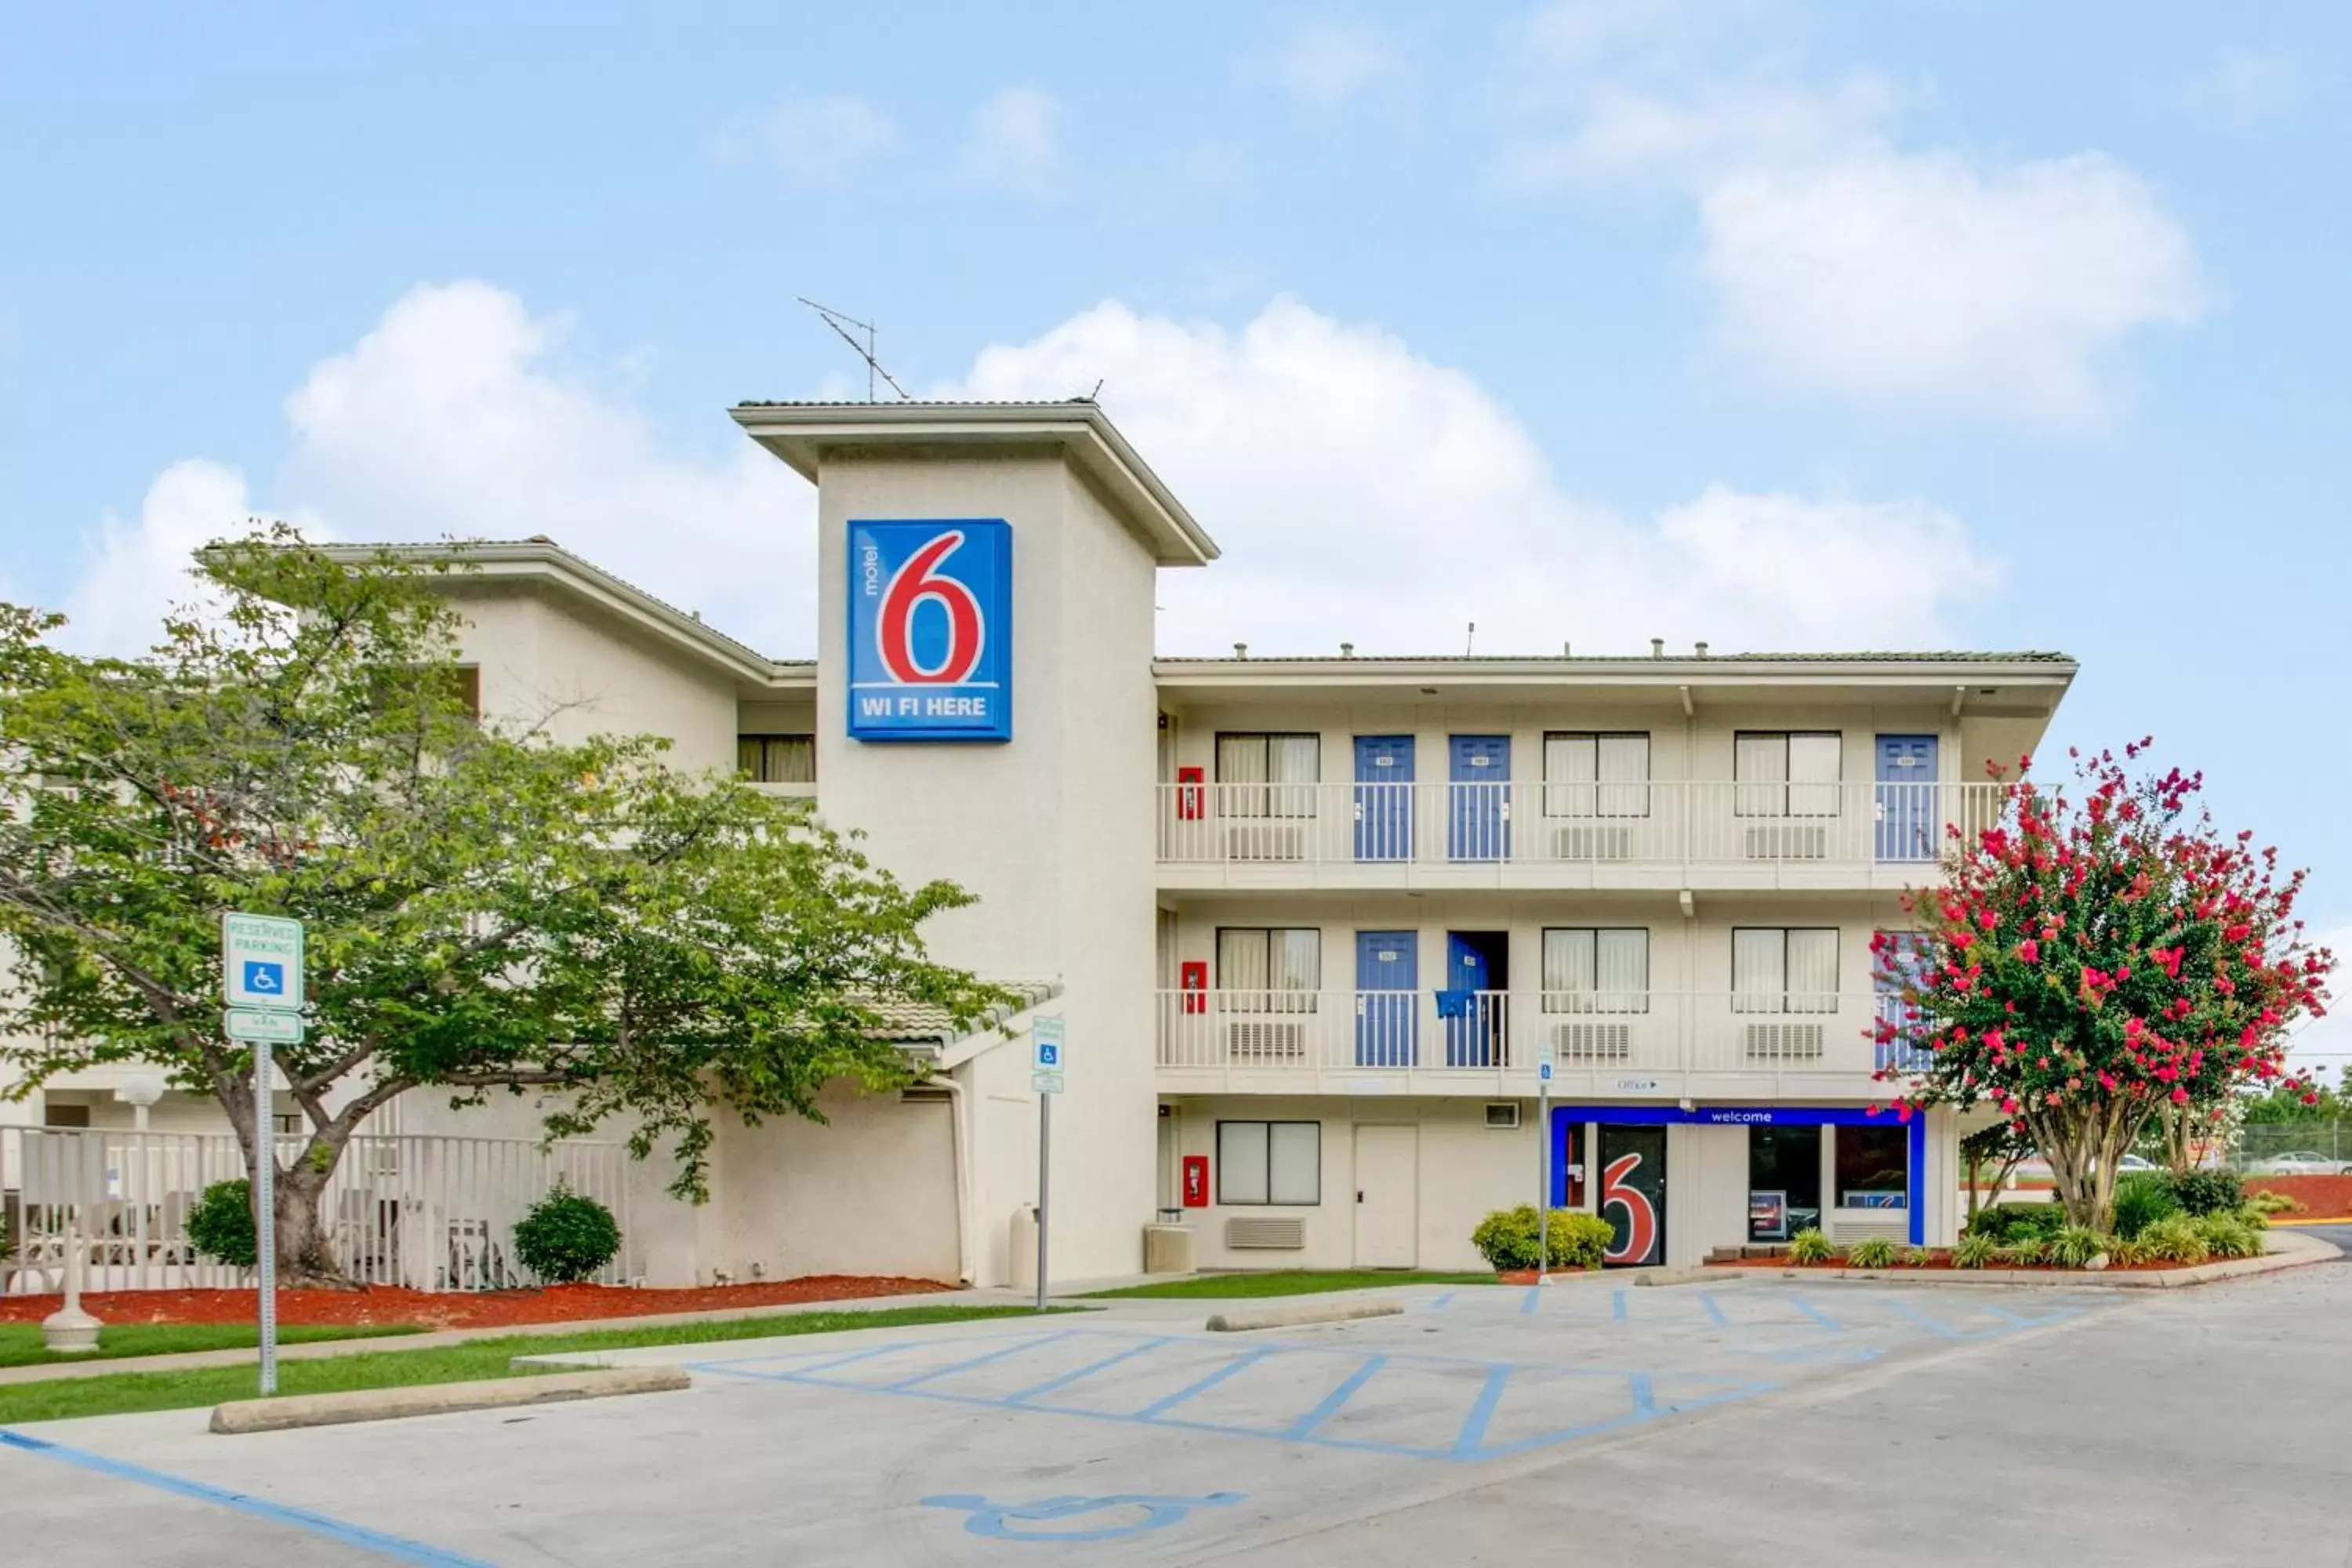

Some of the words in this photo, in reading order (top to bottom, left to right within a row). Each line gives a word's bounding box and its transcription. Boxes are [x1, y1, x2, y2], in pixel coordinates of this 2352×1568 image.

[863, 546, 878, 596] motel
[876, 529, 985, 684] 6
[862, 698, 891, 717] WI
[899, 698, 918, 717] FI
[927, 698, 986, 717] HERE
[229, 922, 295, 939] RESERVED
[234, 938, 293, 954] PARKING
[1711, 1111, 1772, 1122] welcome
